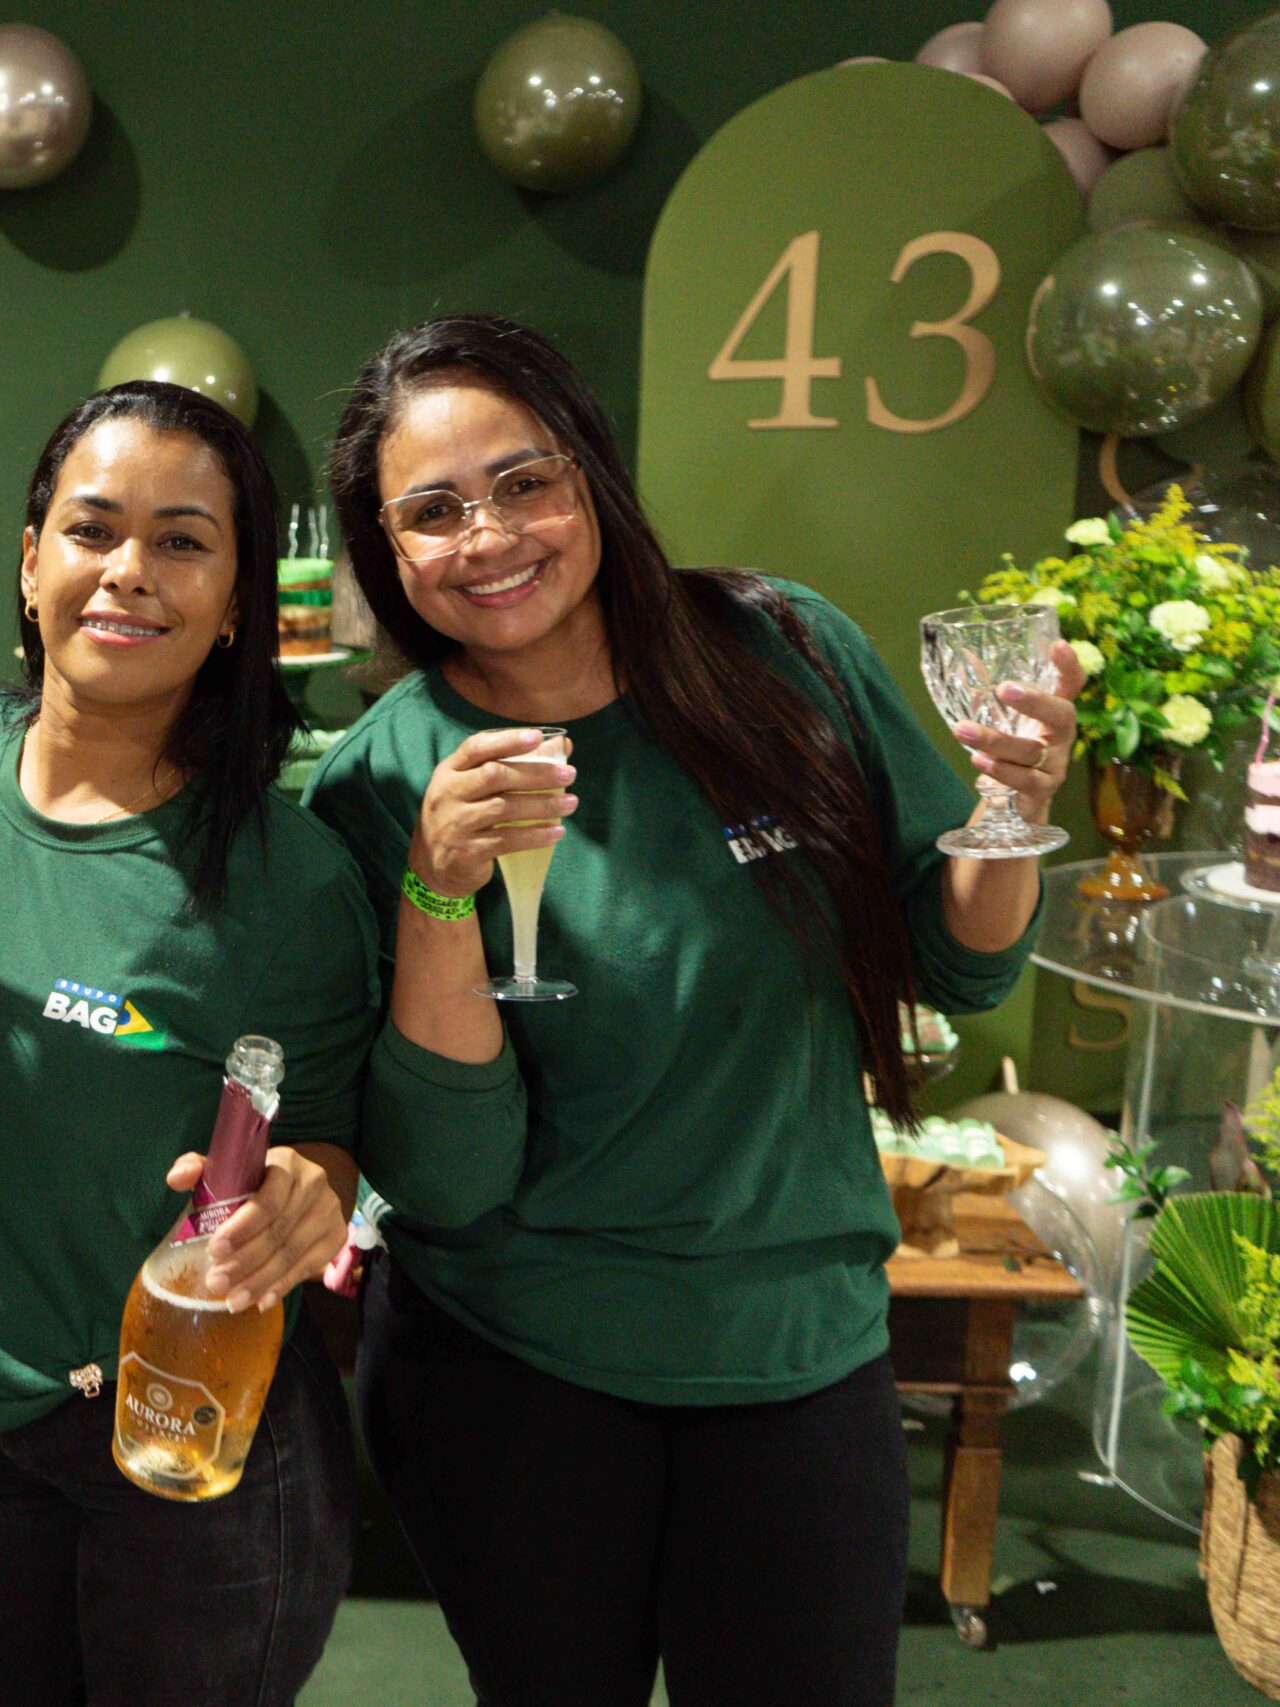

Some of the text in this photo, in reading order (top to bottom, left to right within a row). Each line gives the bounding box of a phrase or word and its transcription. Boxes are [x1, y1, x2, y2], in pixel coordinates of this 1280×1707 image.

[708, 229, 1002, 434] 43
[42, 991, 119, 1034] BAG
[59, 979, 117, 1003] GRUPO
[125, 1393, 196, 1436] AURORA
